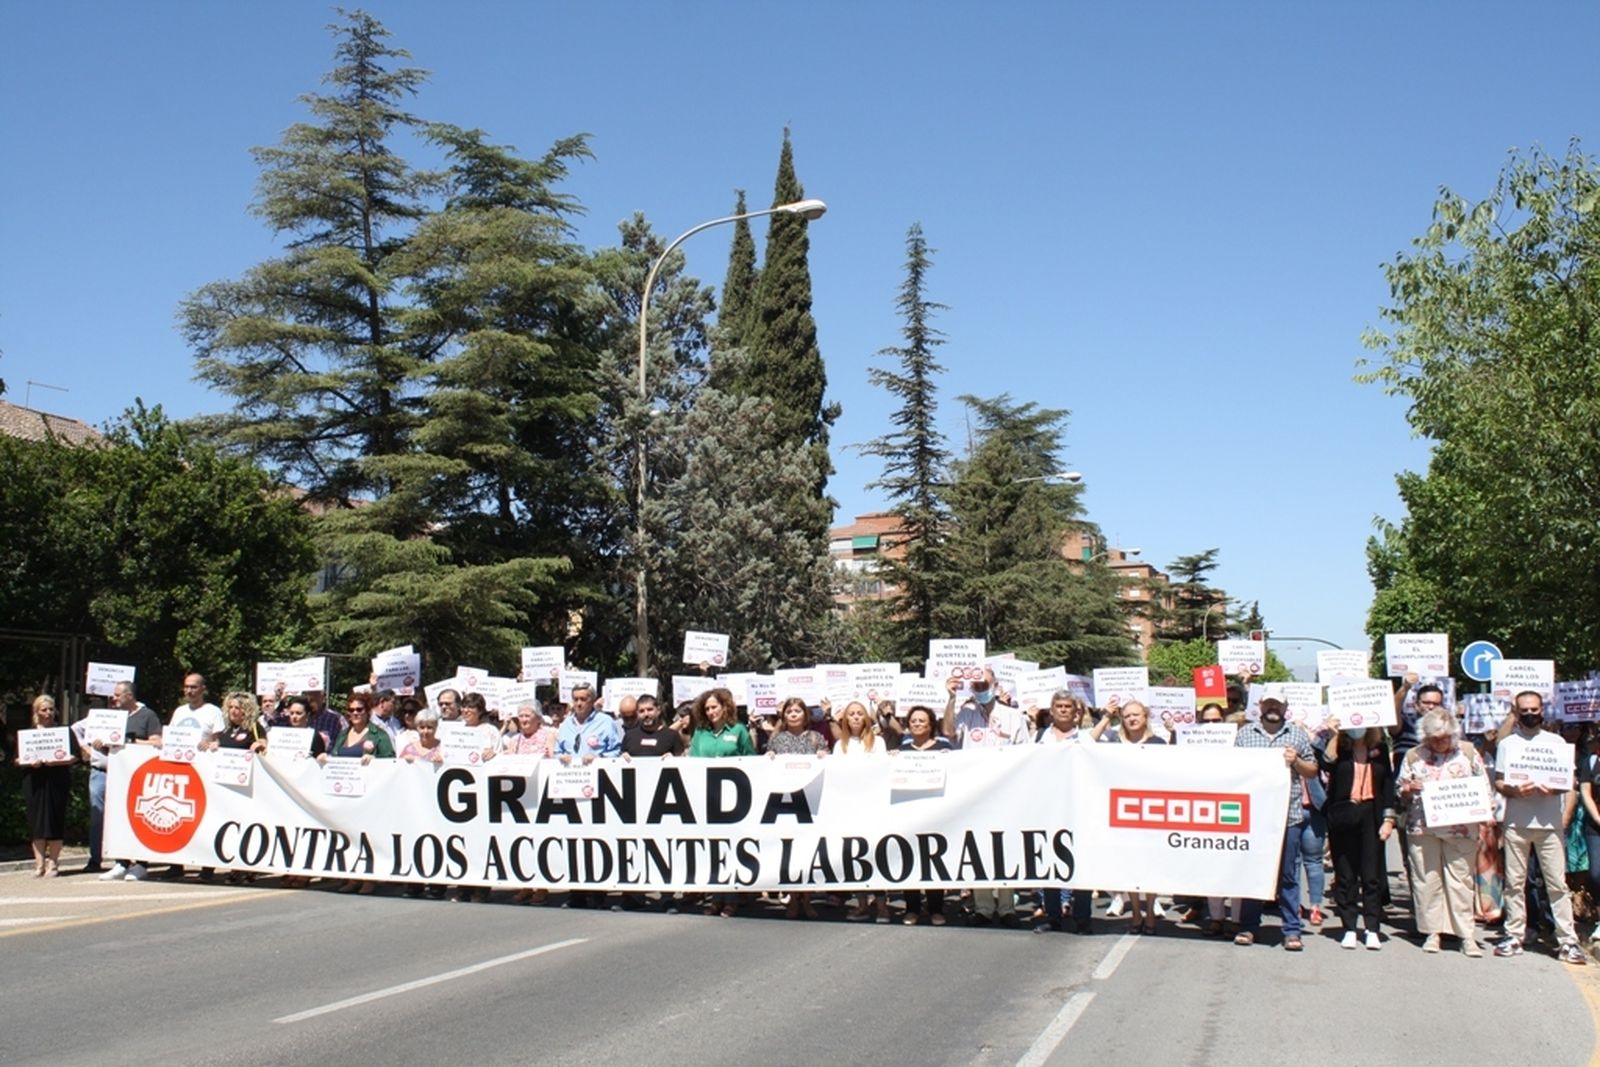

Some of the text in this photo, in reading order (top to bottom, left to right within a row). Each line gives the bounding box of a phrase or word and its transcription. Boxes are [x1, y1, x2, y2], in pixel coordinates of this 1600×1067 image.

[1525, 747, 1555, 755] CARCEL
[1521, 755, 1540, 763] PARA
[1509, 763, 1569, 773] RESPONSABLES
[143, 773, 190, 797] UGT
[436, 767, 814, 825] GRANADA
[1430, 792, 1468, 801] MUERTES
[1117, 797, 1217, 825] CCOO
[1445, 800, 1480, 809] TRABAJO
[1168, 832, 1250, 851] Granada
[213, 821, 1076, 887] CONTRA LOS ACCIDENTES LABORALES
